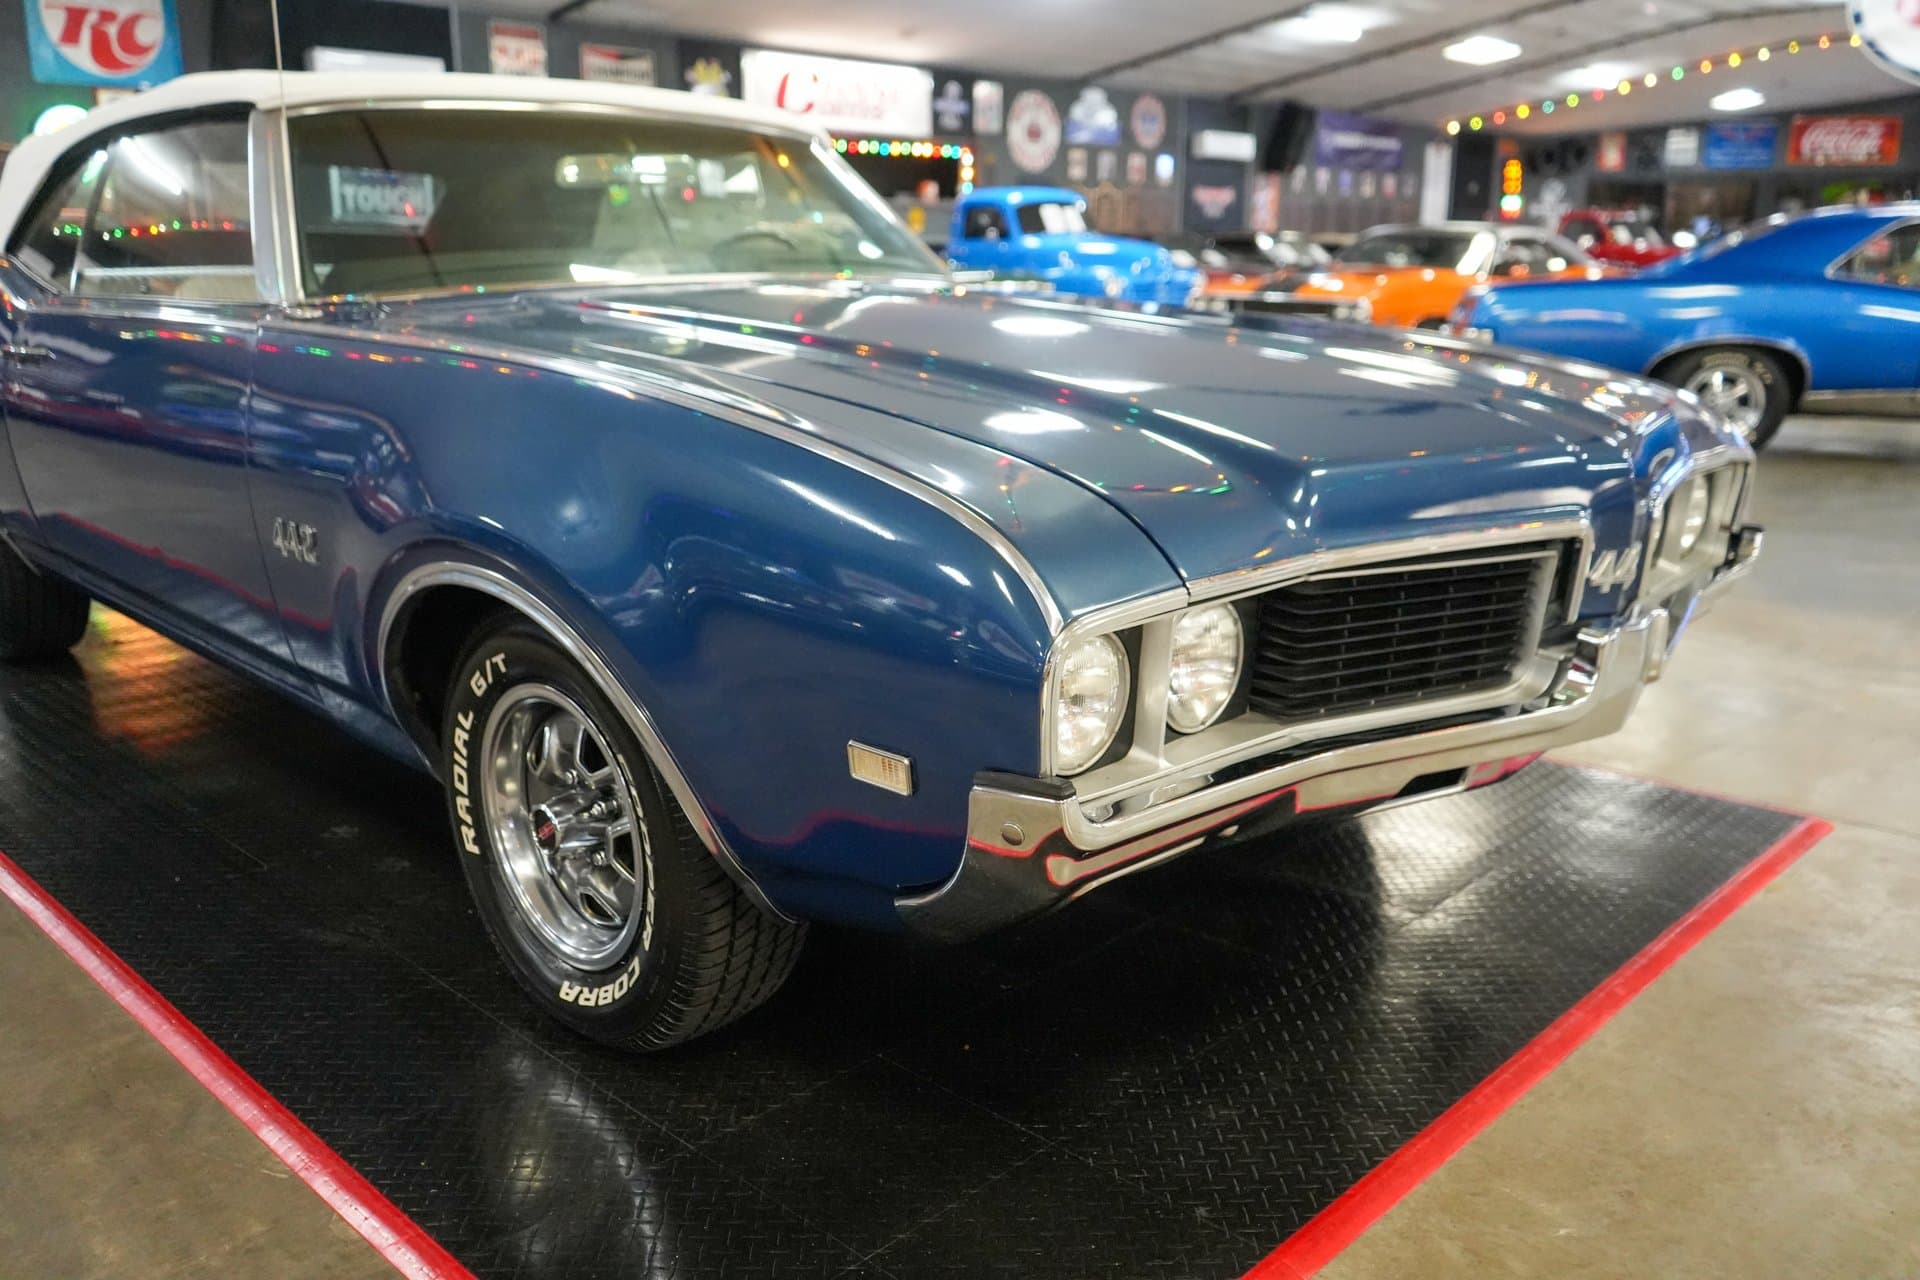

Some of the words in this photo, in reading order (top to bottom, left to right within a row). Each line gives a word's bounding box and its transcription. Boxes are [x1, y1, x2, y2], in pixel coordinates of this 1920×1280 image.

[56, 5, 158, 71] RC
[272, 516, 318, 567] 442
[453, 710, 480, 854] RADIAL
[470, 652, 507, 698] G/T
[617, 753, 655, 951] COOPER
[559, 955, 640, 1007] COBRA
